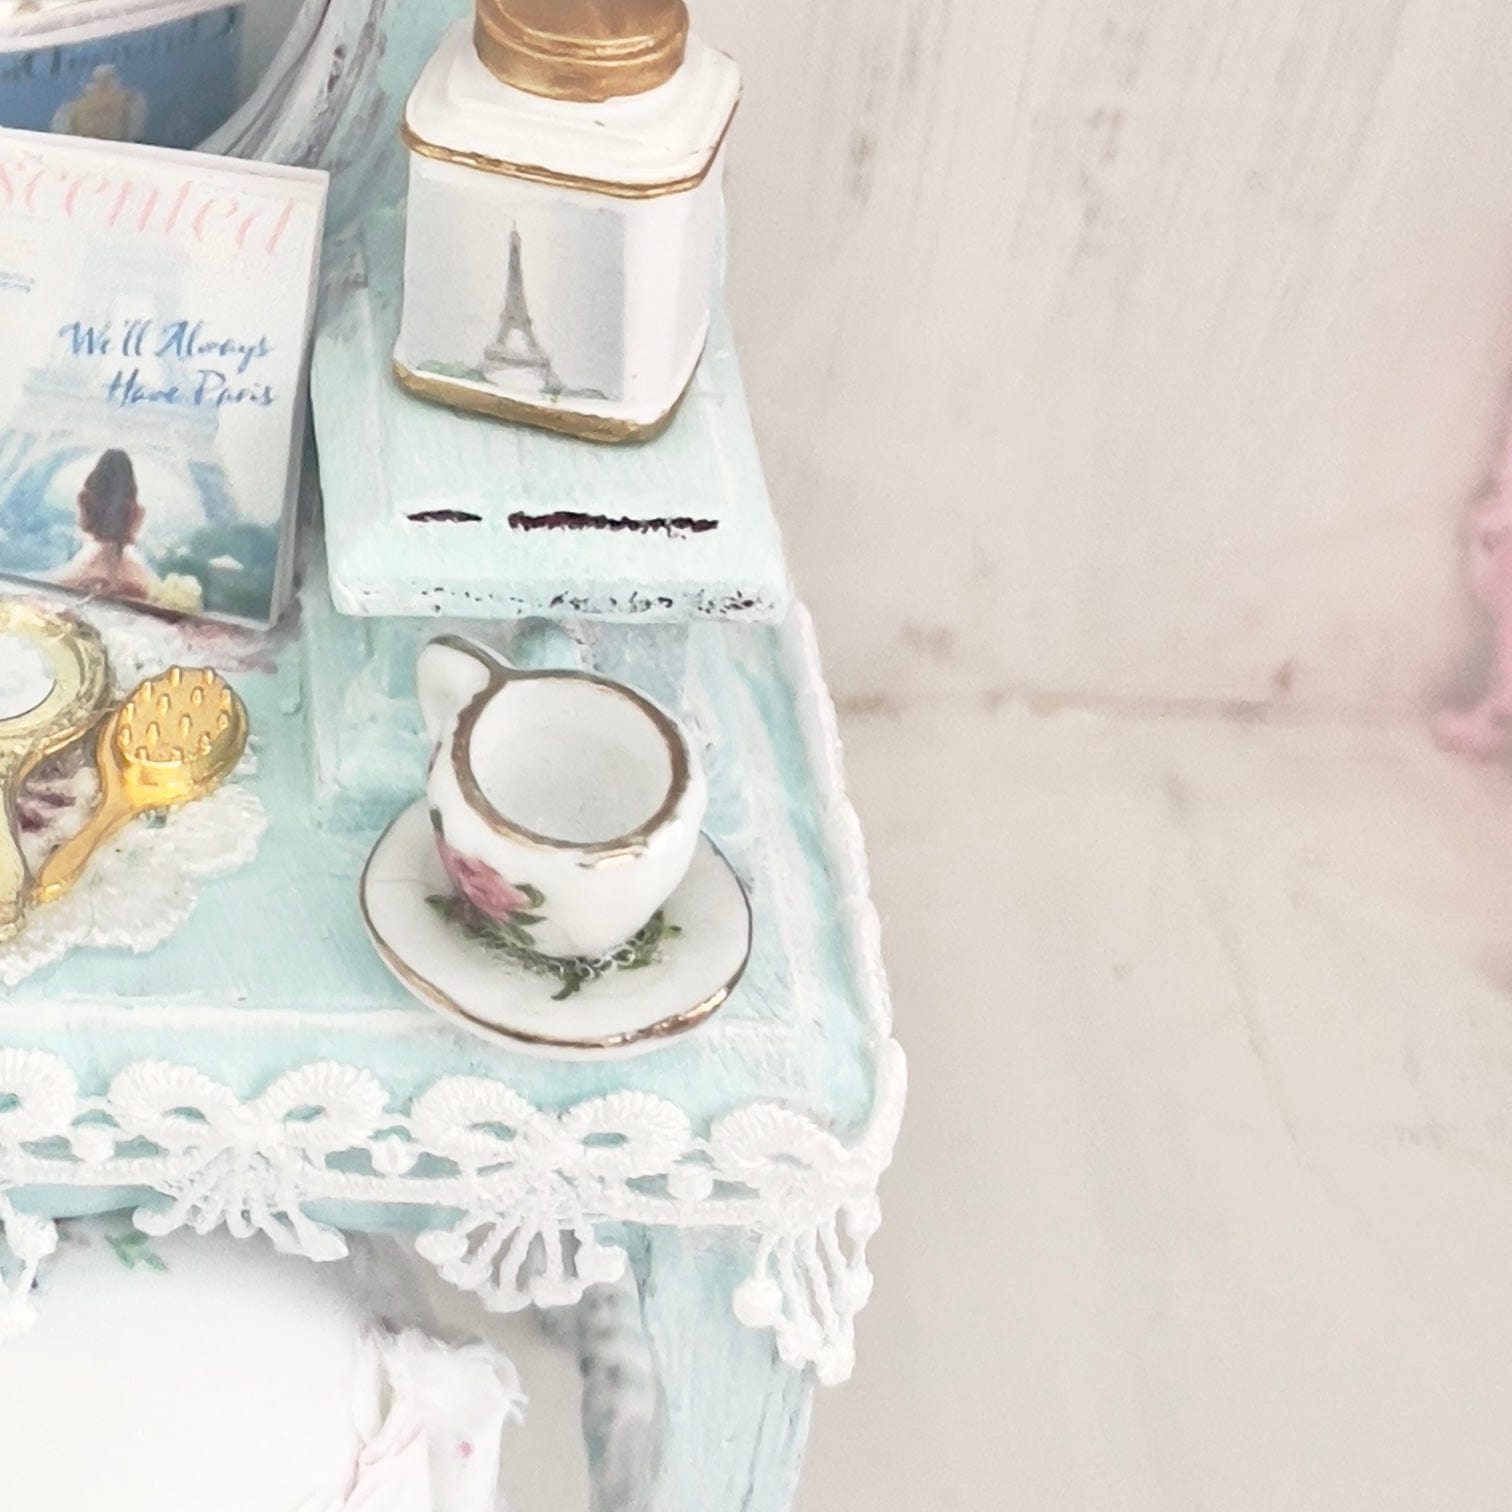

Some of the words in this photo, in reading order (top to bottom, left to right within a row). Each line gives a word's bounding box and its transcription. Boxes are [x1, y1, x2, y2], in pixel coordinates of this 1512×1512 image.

[59, 319, 152, 357] We'll
[155, 319, 274, 374] Always
[104, 369, 180, 407] Have
[194, 369, 275, 406] Paris
